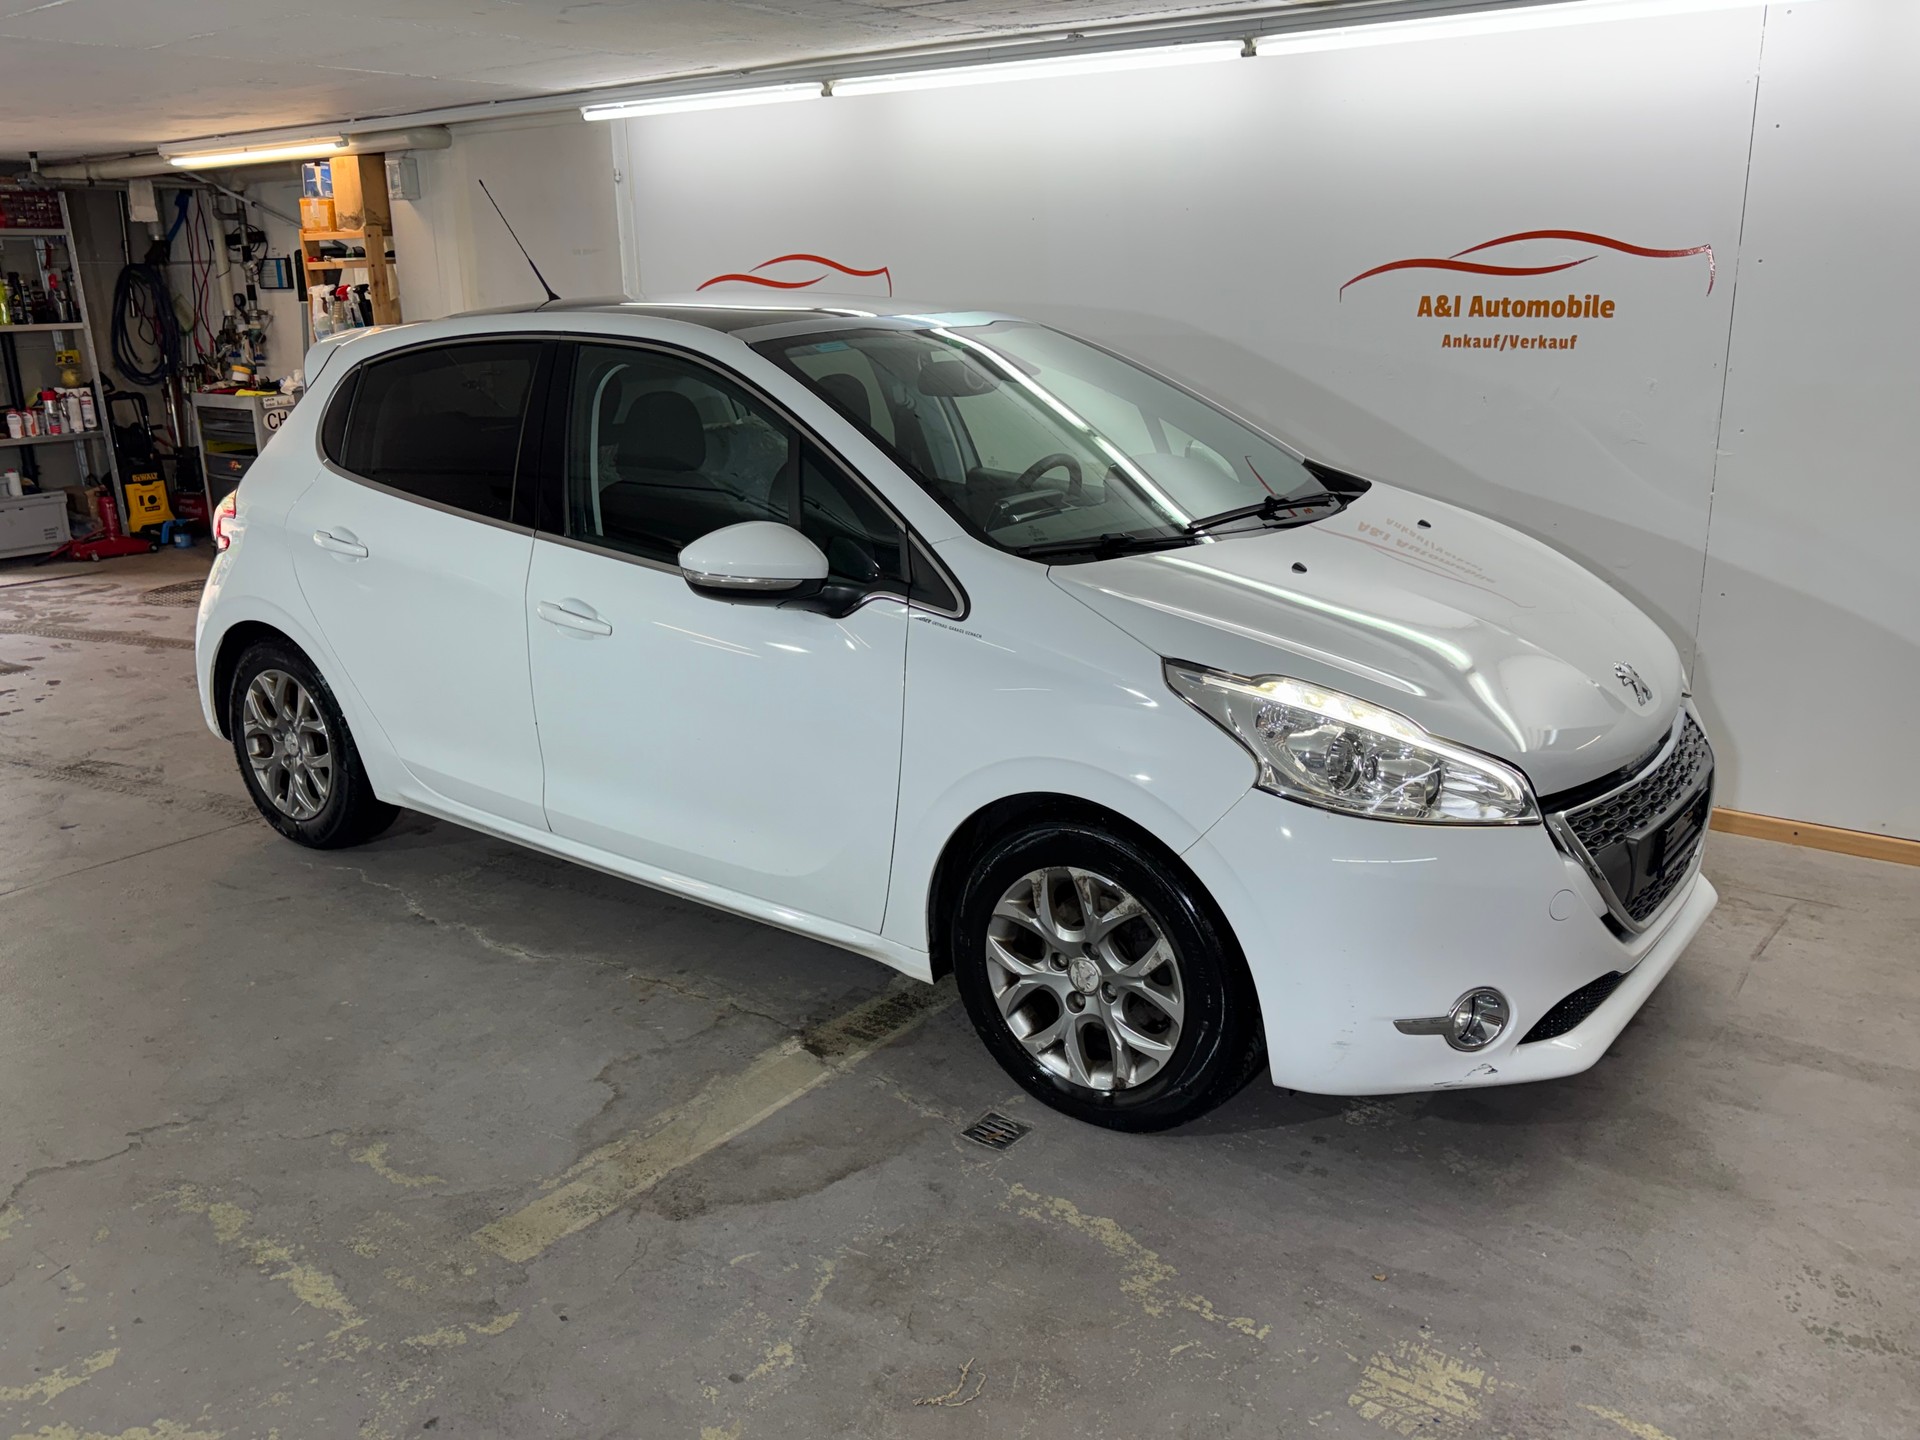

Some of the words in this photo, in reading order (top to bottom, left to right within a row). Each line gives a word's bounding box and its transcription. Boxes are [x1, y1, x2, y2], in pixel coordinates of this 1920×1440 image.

[1417, 294, 1461, 317] A&I
[1468, 294, 1615, 318] Automobile
[1442, 334, 1577, 351] Ankauf/Verkauf
[267, 411, 287, 429] CH
